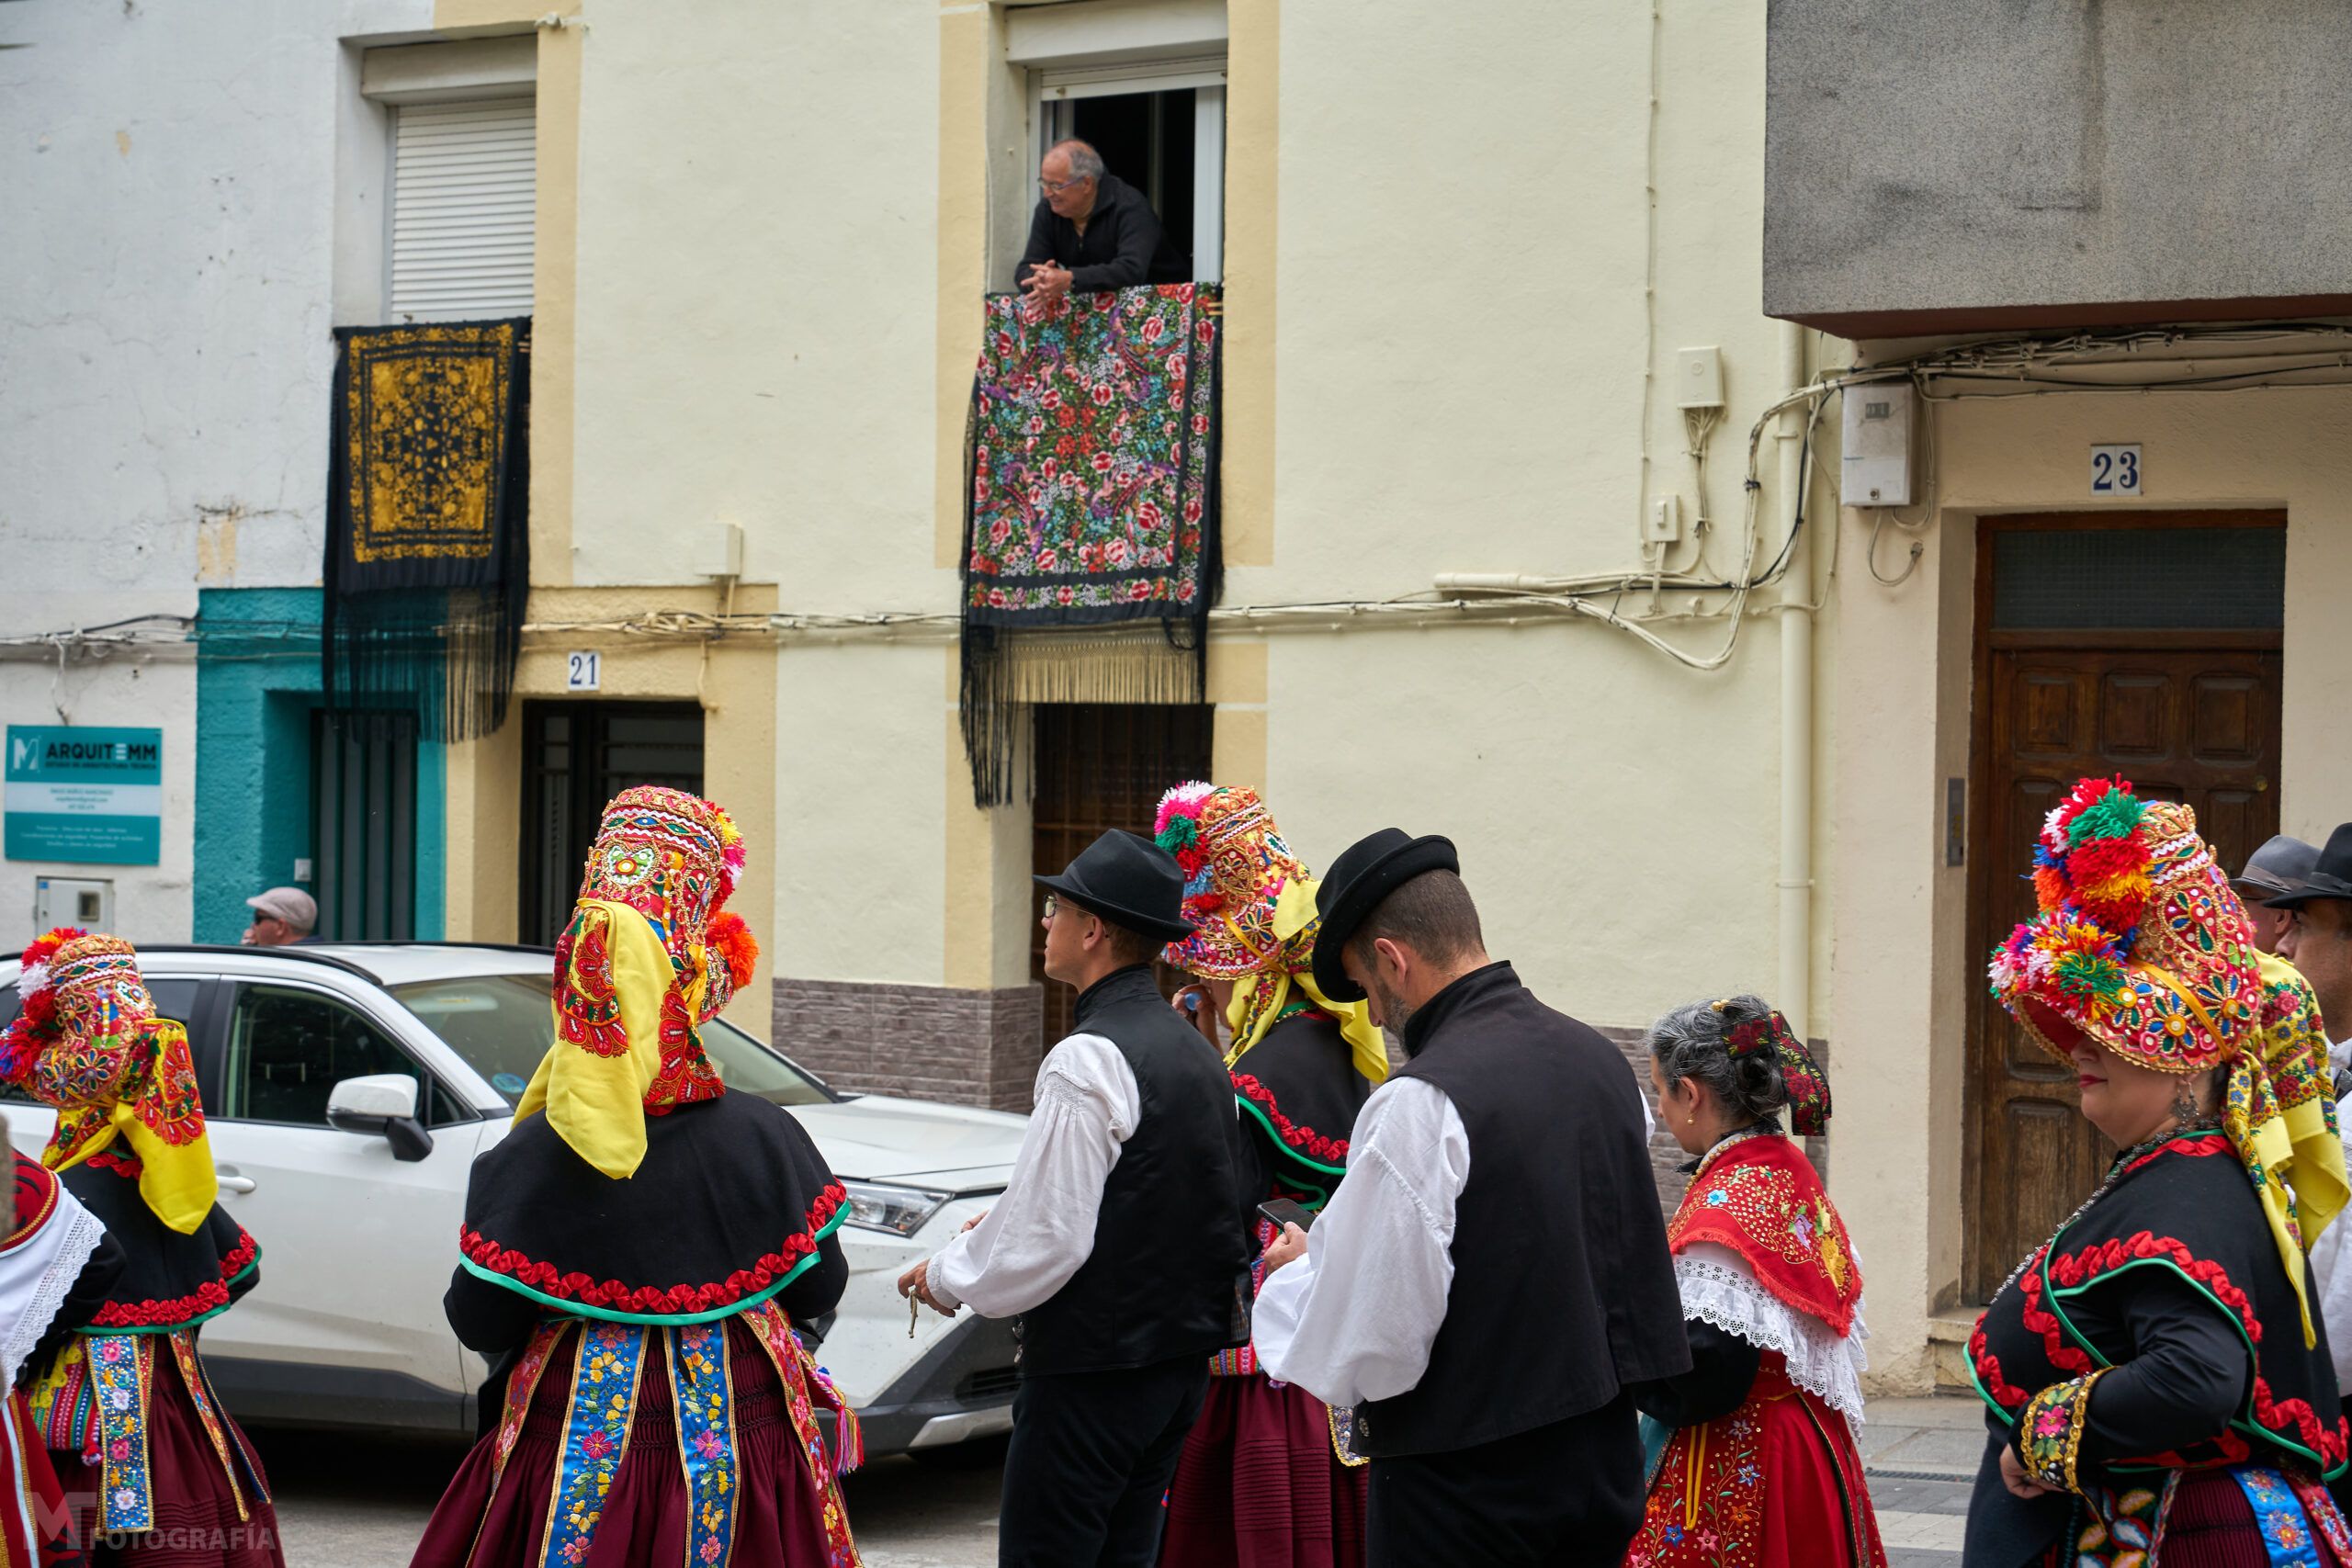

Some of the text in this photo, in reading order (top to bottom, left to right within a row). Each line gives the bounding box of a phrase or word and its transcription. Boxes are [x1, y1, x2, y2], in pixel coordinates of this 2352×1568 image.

[2093, 451, 2138, 491] 23
[570, 654, 596, 685] 21
[47, 742, 157, 761] ARQUITEMM
